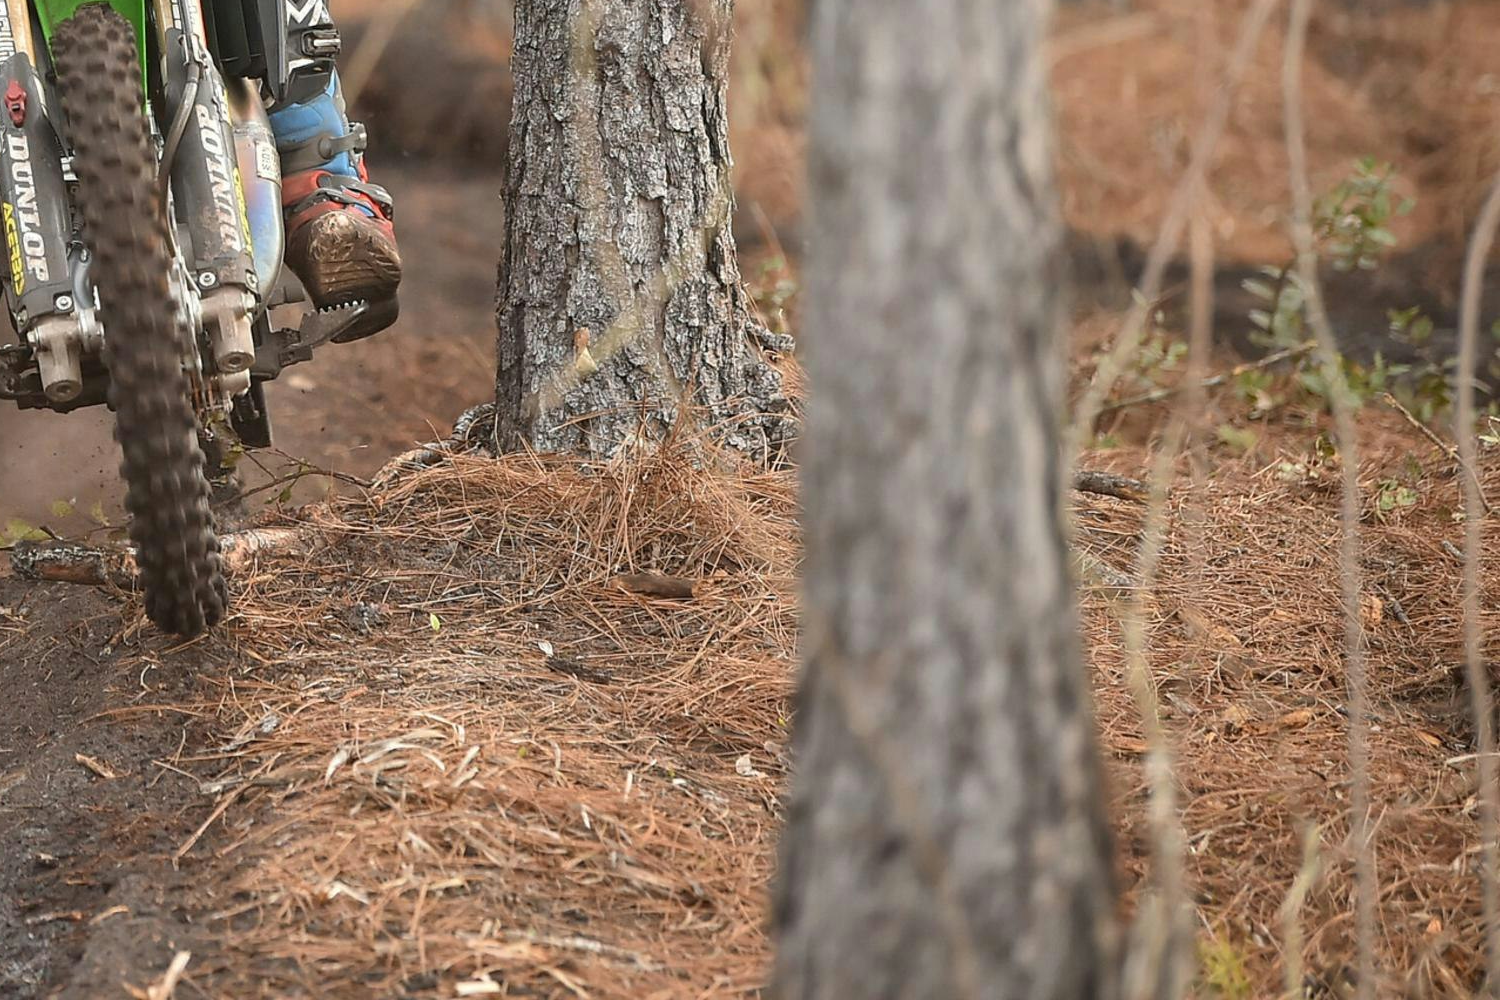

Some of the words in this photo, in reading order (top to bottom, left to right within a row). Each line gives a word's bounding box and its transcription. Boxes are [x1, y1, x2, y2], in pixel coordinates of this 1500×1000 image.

[3, 202, 26, 296] ACERBIS
[7, 133, 49, 282] DUNLOP
[195, 103, 242, 252] DUNLOP
